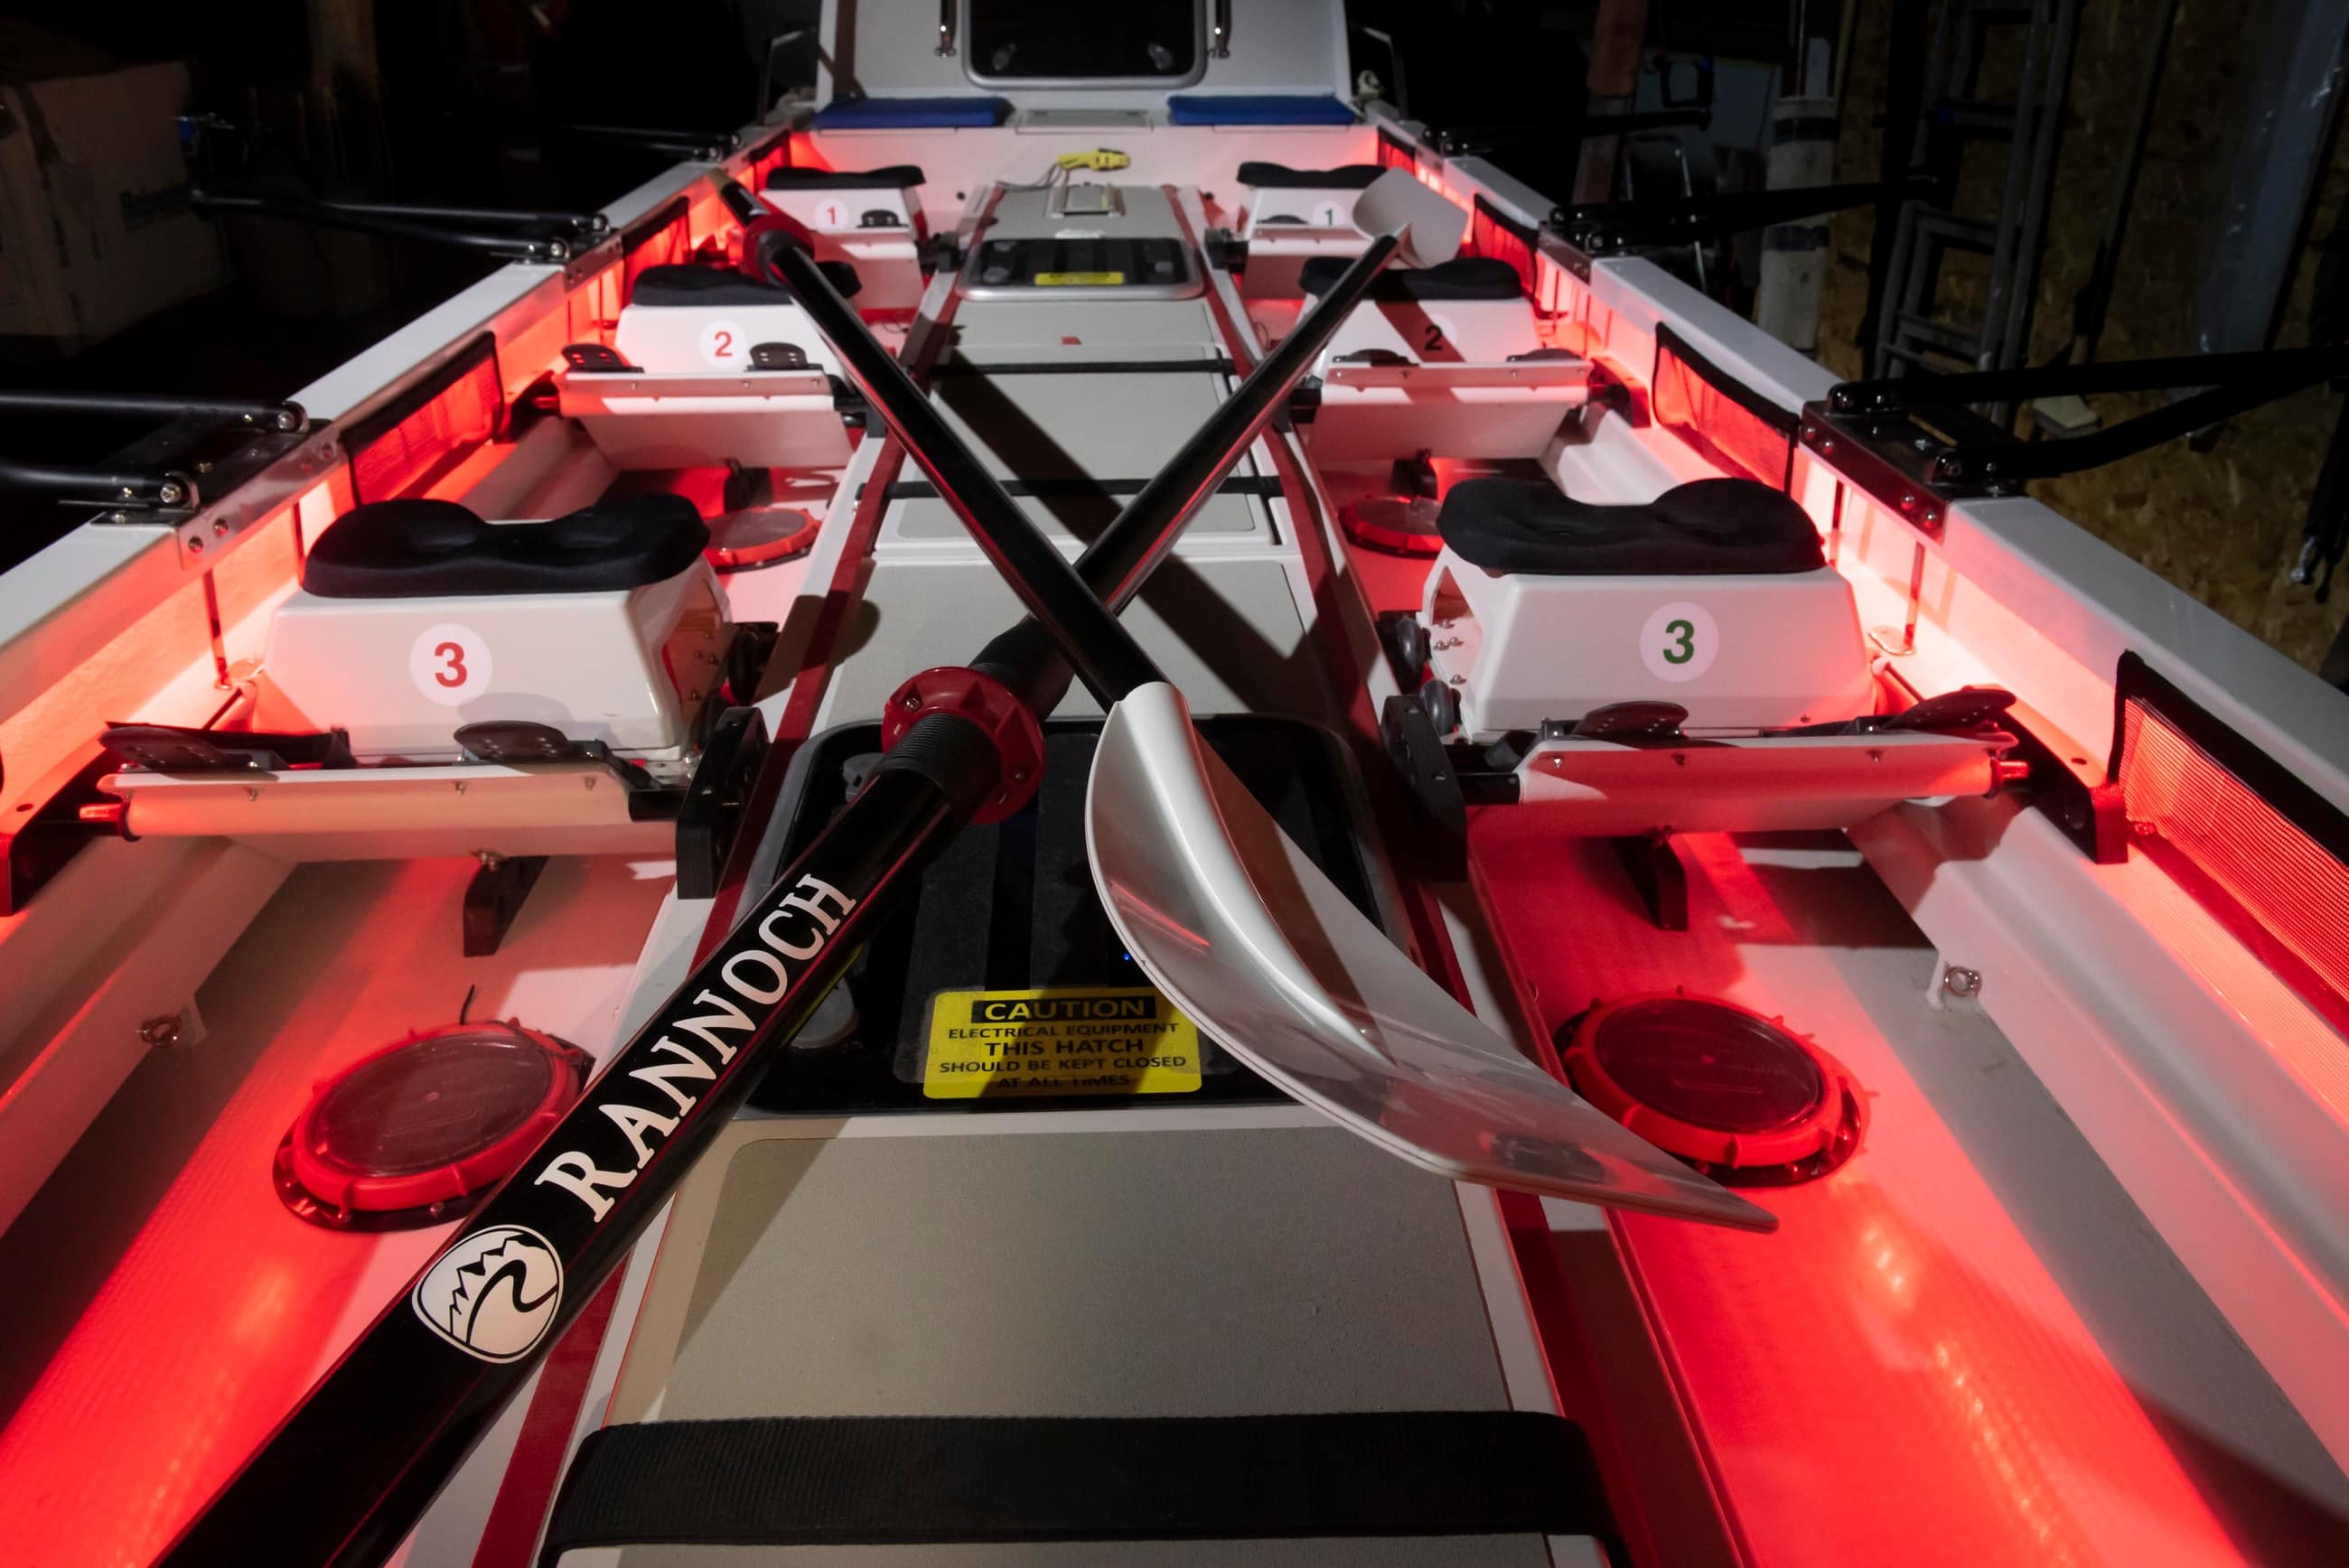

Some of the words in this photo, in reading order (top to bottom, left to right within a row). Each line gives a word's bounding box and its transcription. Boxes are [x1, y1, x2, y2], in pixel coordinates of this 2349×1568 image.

[826, 205, 837, 225] 1
[1324, 208, 1334, 227] 1
[714, 331, 734, 357] 2
[1425, 324, 1444, 351] 2
[1662, 619, 1695, 665] 3
[434, 641, 468, 688] 3
[984, 1000, 1146, 1021] CAUTION
[949, 1025, 1059, 1039] ELECTRICAL
[1066, 1022, 1179, 1036] EQUIPMENT
[534, 873, 856, 1223] RANNOCH
[985, 1041, 1045, 1057] THIS
[1055, 1038, 1144, 1055] HATCH
[940, 1060, 1021, 1073] SHOULD
[1027, 1059, 1050, 1071] BE
[1059, 1058, 1108, 1070] KEPT
[1113, 1056, 1186, 1069] CLOSED
[997, 1078, 1022, 1088] AT
[1027, 1077, 1061, 1087] ALL
